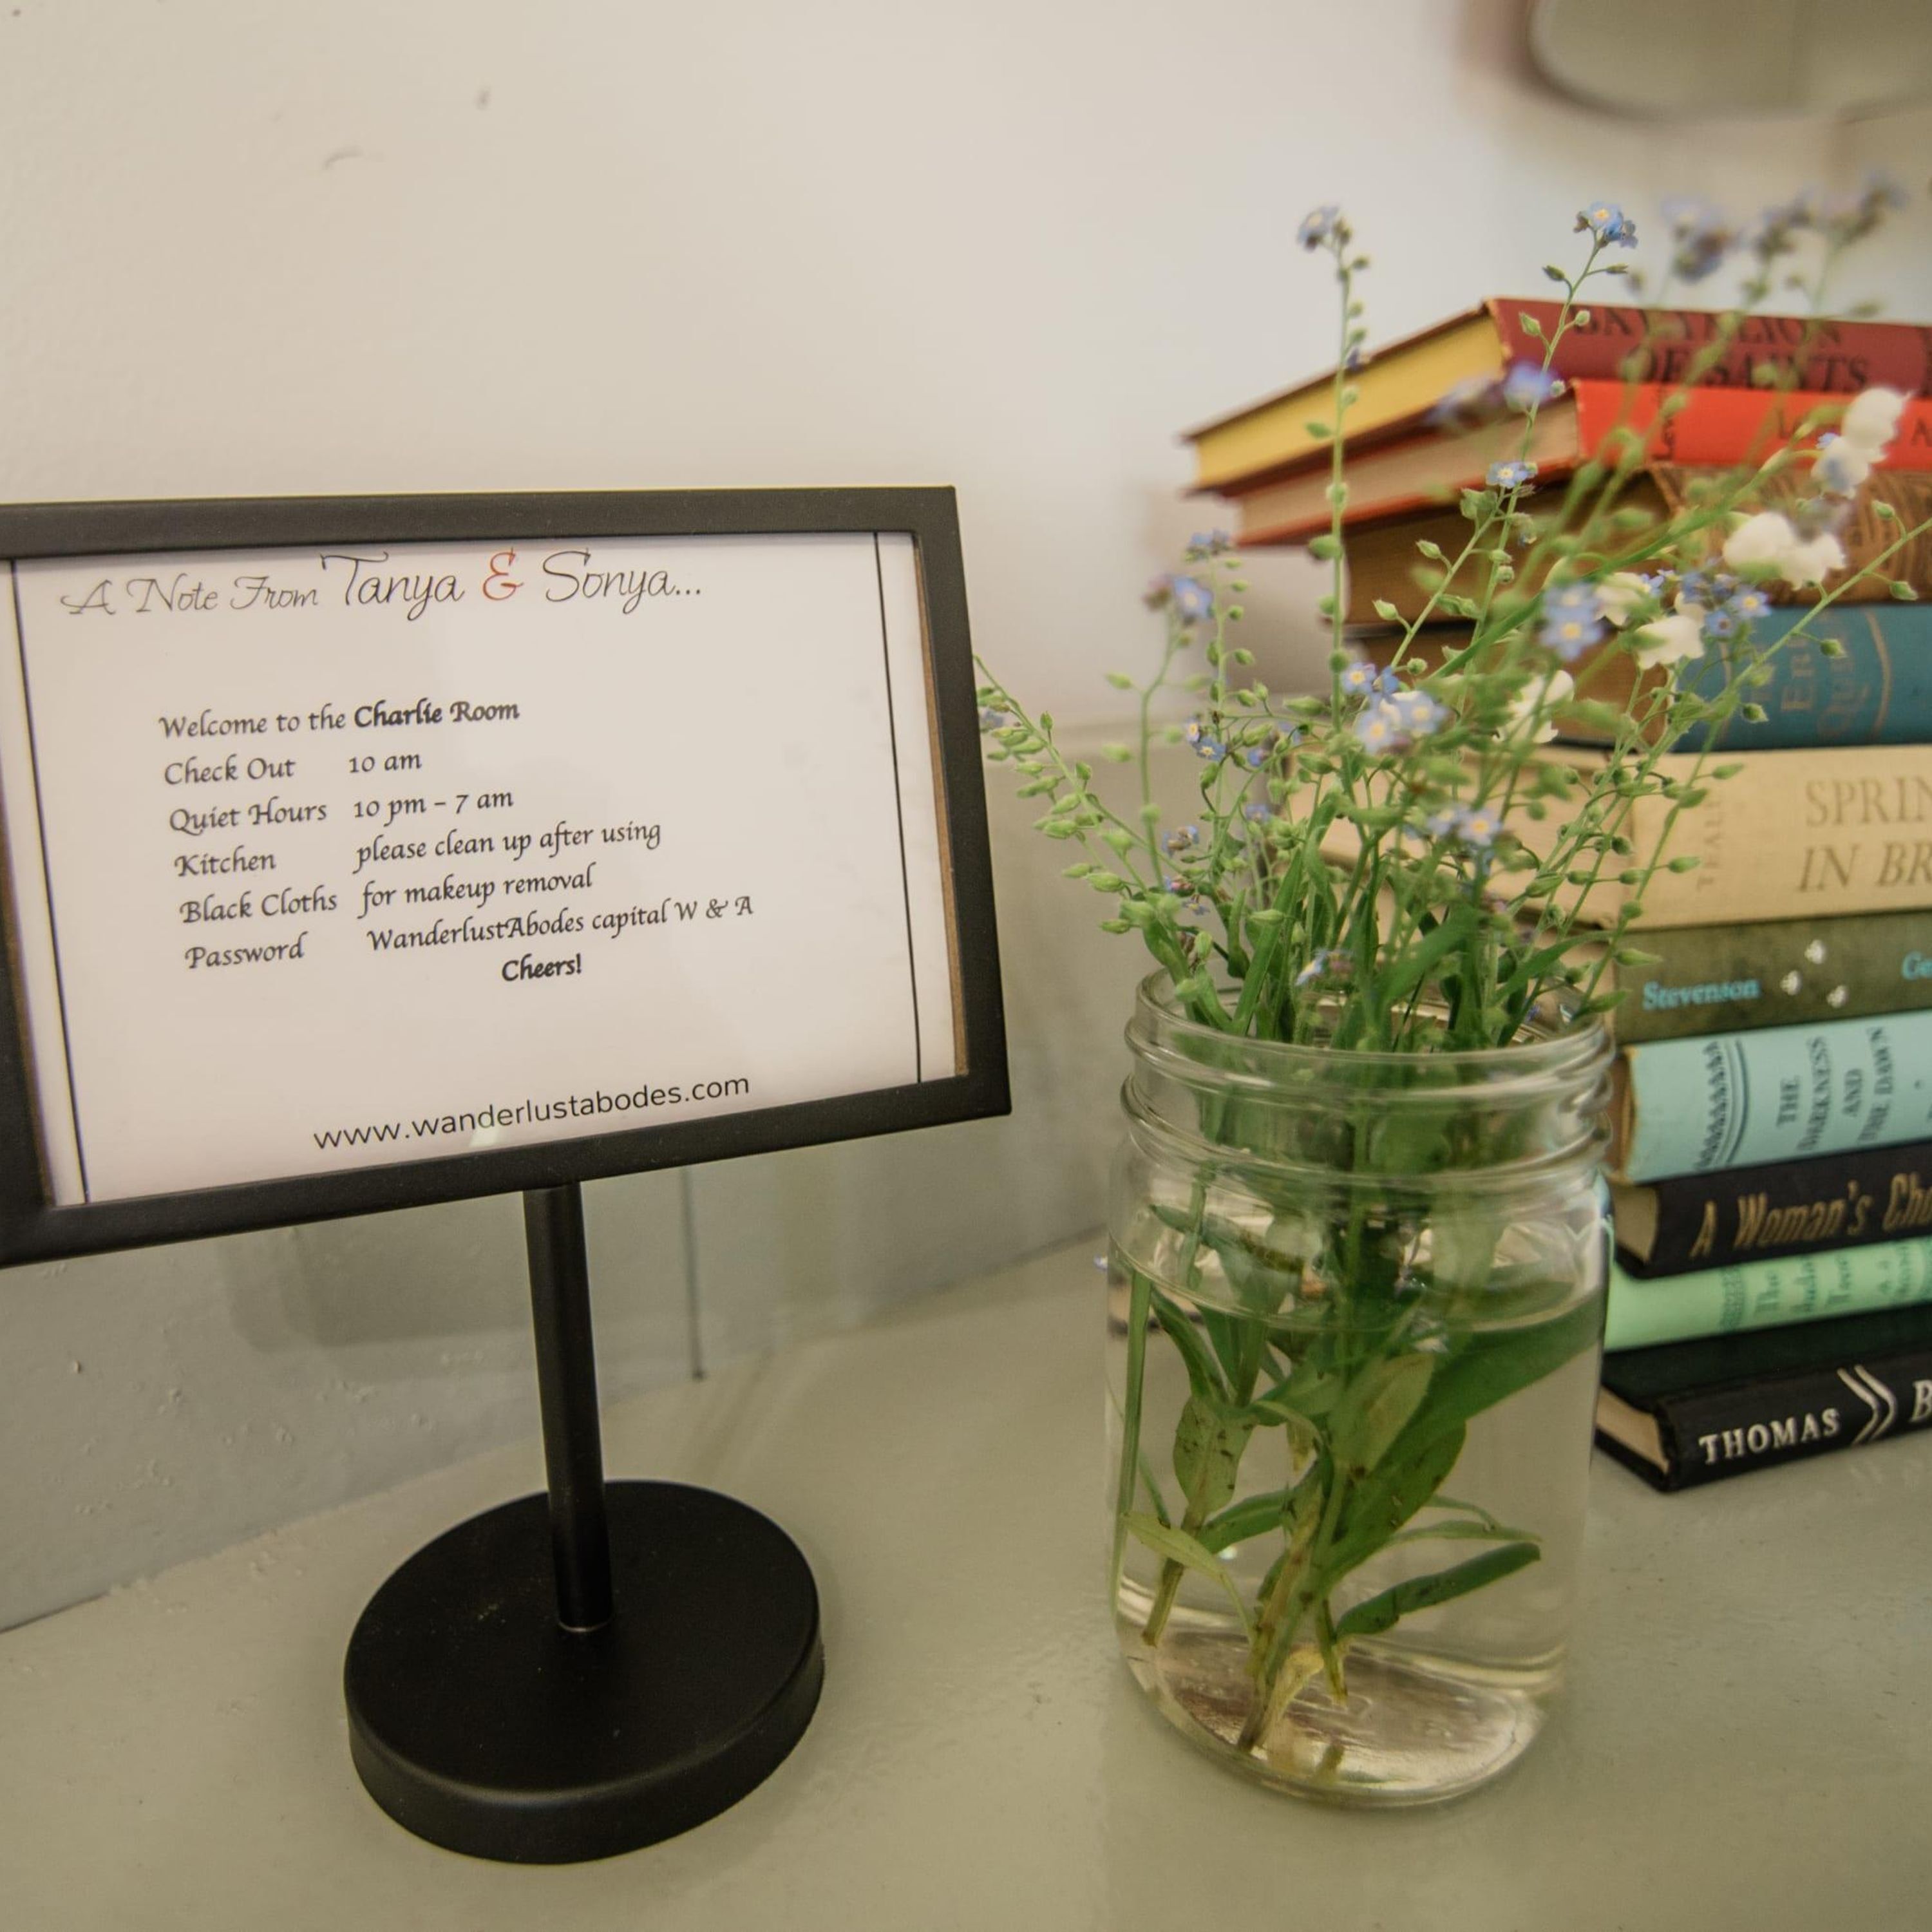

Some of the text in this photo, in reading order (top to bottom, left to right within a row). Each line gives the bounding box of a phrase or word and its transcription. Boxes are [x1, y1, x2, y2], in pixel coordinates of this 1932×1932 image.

[61, 580, 115, 615] A
[127, 574, 217, 612] Note
[231, 576, 317, 609] From
[321, 553, 465, 621] Tanya
[482, 549, 524, 601] &
[158, 697, 520, 738] Welcome to the Charlie Room
[164, 754, 422, 785] Check Out 10 am
[169, 807, 241, 836] Quiet
[247, 796, 327, 825] Hours
[354, 800, 379, 818] 10
[384, 799, 426, 827] pm
[456, 795, 469, 814] 7
[477, 792, 513, 809] am
[174, 820, 660, 877] Kitchen please clean up after using
[1799, 843, 1863, 893] IN
[179, 862, 596, 923] Black Cloths for makeup removal
[184, 896, 753, 969] Password WanderlustAbodes capital W & A
[502, 953, 582, 981] Cheers!
[1643, 978, 1762, 1010] Stevenson
[314, 1078, 748, 1149] www.wanderlustabodes.com
[1776, 1075, 1801, 1128] THE
[1842, 1068, 1864, 1118] AND
[1689, 1200, 1718, 1258] A
[1734, 1179, 1873, 1251] Woman's
[1698, 1408, 1841, 1465] THOMAS
